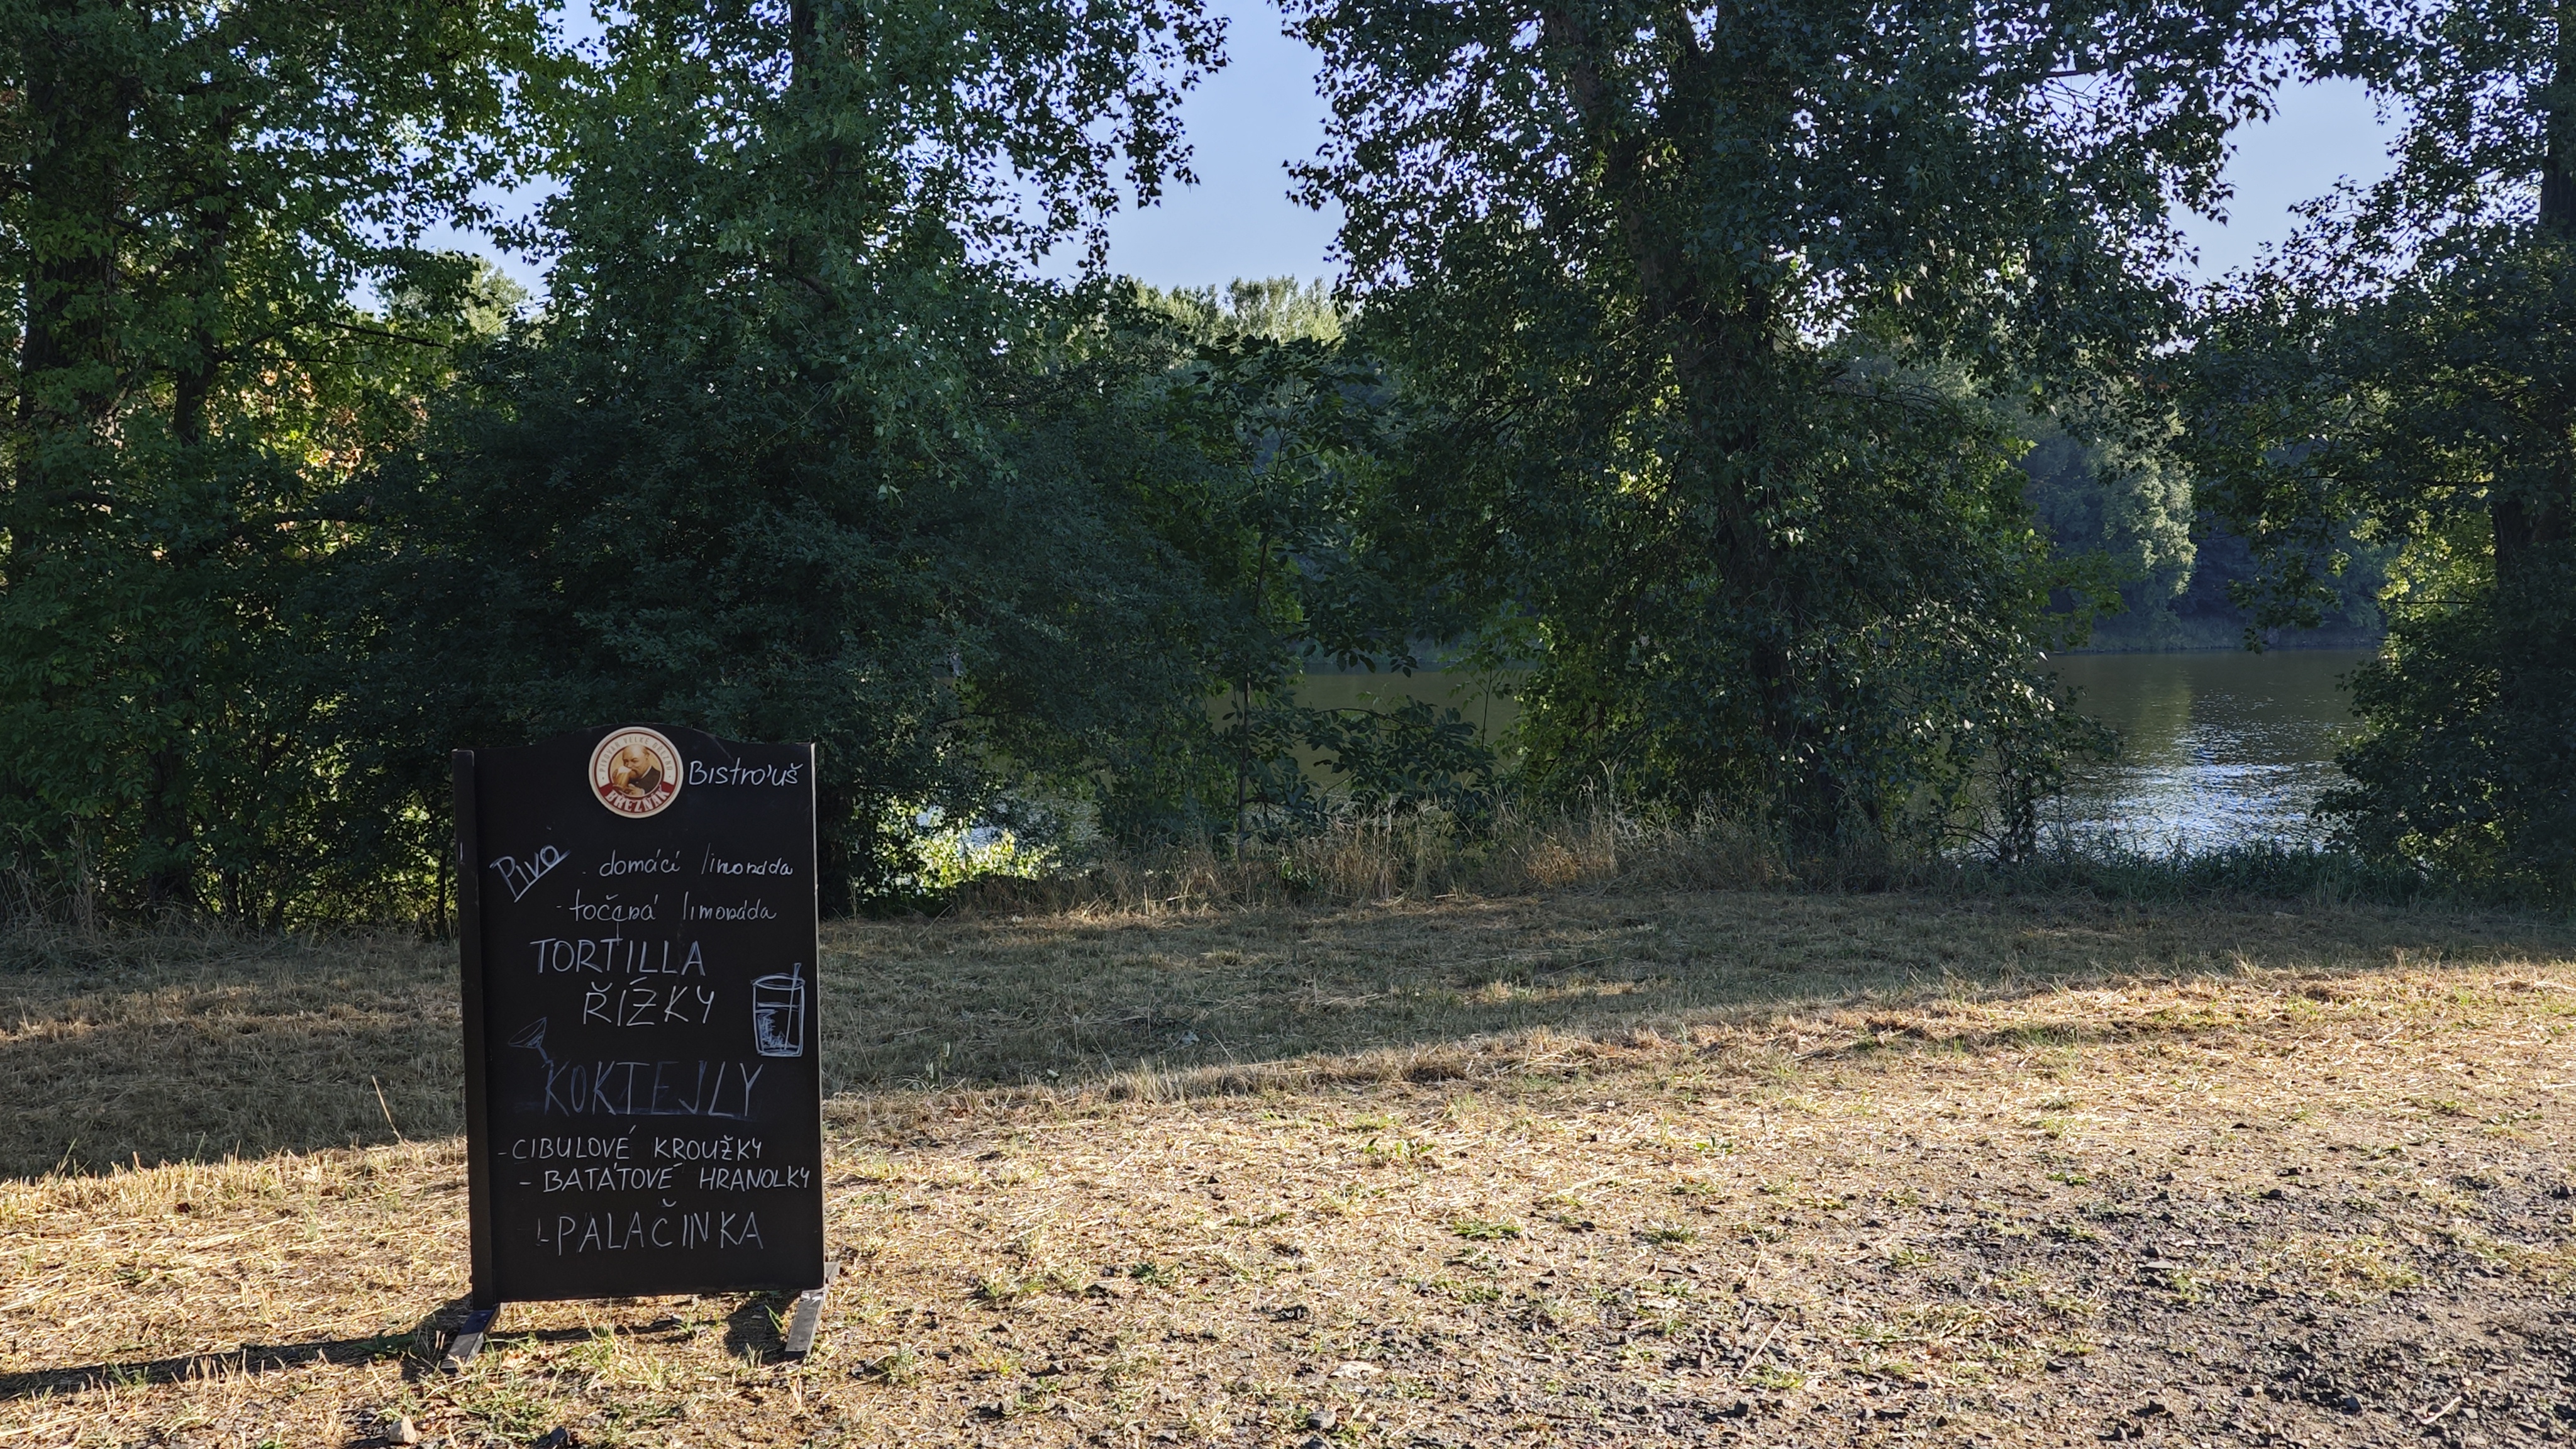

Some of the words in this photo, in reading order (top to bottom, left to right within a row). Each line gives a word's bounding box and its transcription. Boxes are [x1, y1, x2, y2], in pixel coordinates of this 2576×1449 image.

[489, 845, 564, 900] Pivo
[599, 849, 680, 877] domácí
[683, 891, 777, 921] limonáda
[530, 938, 706, 976] TORTILLA
[543, 1060, 763, 1118] KOKTEJLY
[513, 1125, 636, 1160] CIBULOVÉ
[654, 1135, 762, 1161] KROUŽKY
[543, 1162, 682, 1193] BATÁTOVÉ
[699, 1165, 810, 1192] HRANOLKY
[558, 1197, 763, 1257] PALAČINKA
